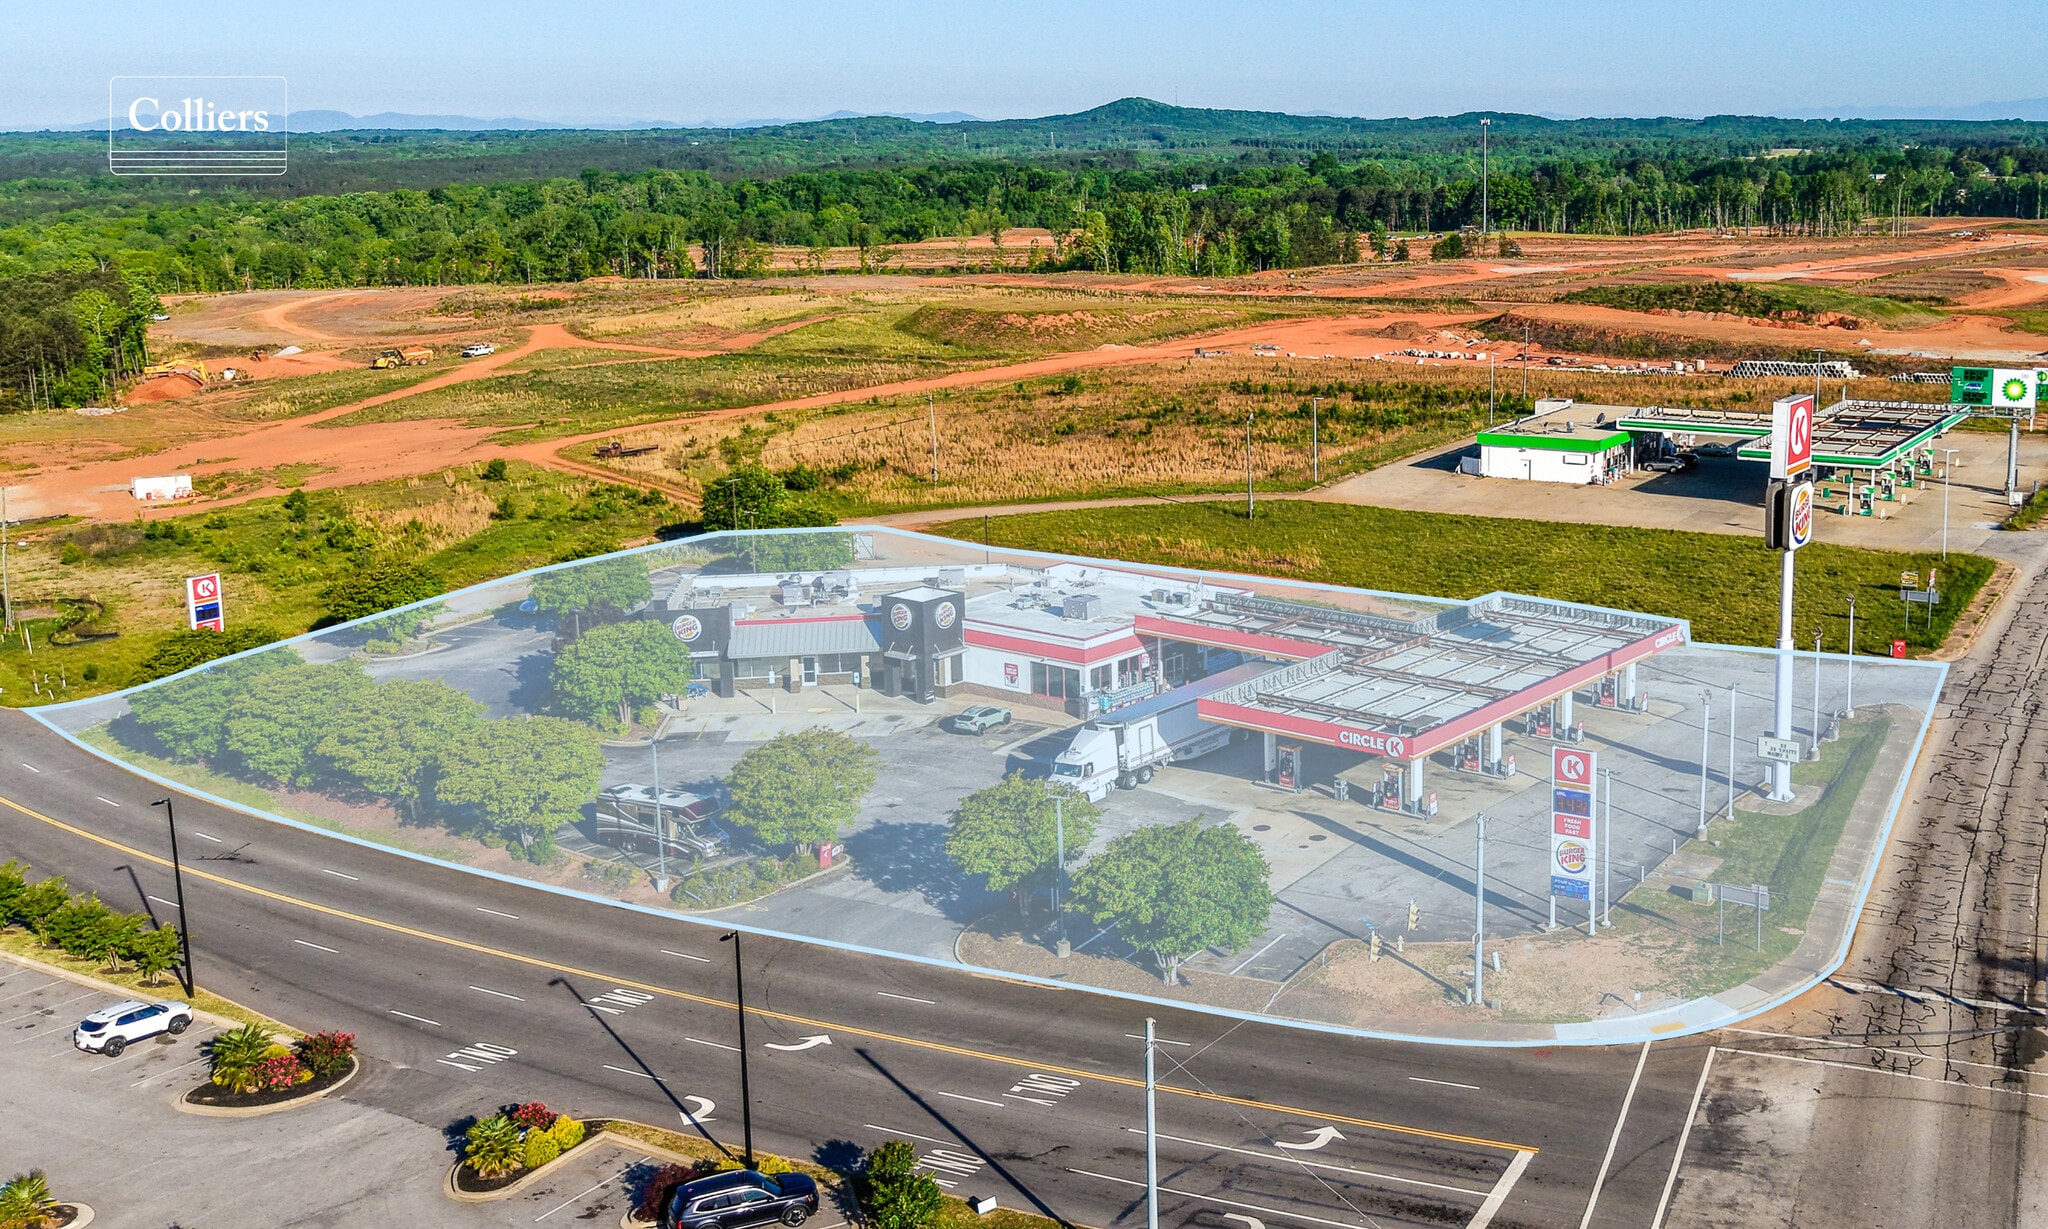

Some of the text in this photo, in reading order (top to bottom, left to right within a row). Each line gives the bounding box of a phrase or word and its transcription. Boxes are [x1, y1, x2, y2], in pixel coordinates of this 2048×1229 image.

[1794, 411, 1806, 453] K
[1795, 495, 1810, 519] BURGER
[1795, 508, 1810, 536] KING
[200, 582, 214, 595] K
[678, 624, 698, 636] KING
[1655, 631, 1677, 648] CIRCLE
[1339, 731, 1402, 757] CIRCLE K
[1565, 758, 1582, 778] K
[1560, 848, 1585, 856] BURGER
[1561, 854, 1586, 864] KING
[580, 988, 655, 1015] ONLY
[437, 1042, 518, 1072] ONLY
[1002, 1073, 1081, 1106] ONLY
